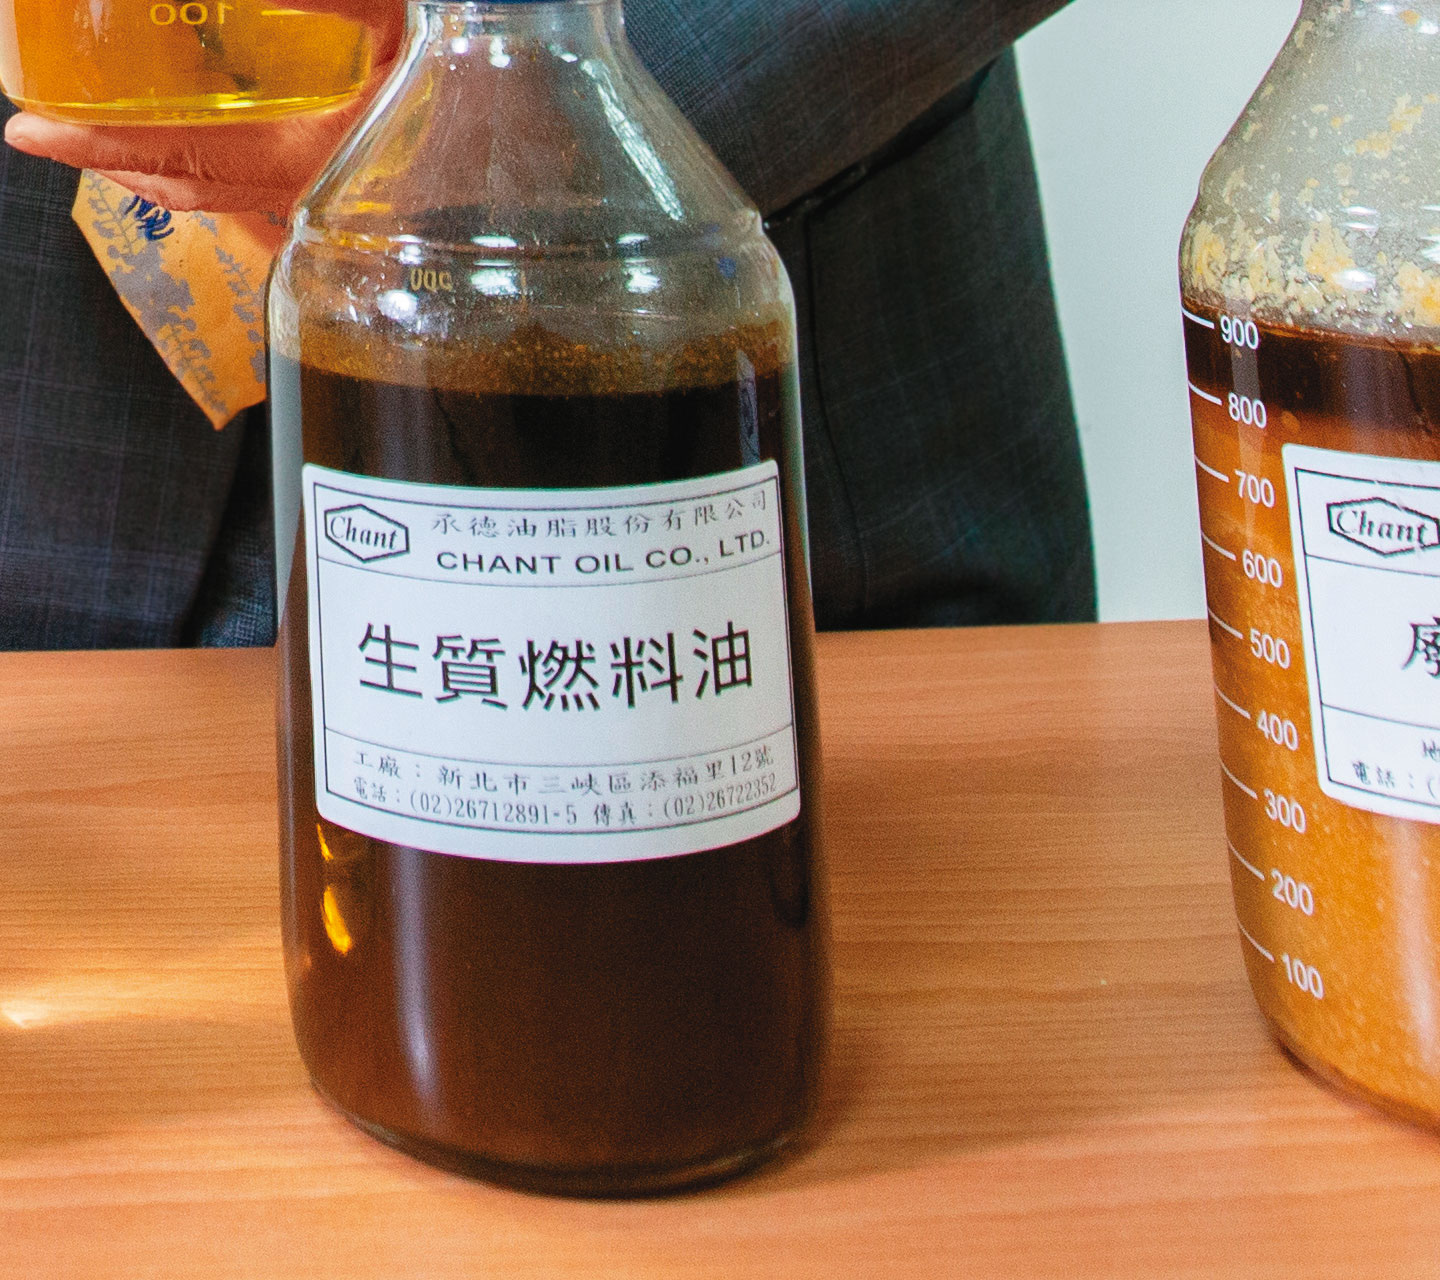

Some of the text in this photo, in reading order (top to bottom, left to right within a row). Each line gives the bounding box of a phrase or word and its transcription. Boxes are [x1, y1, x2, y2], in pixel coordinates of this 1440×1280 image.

[1220, 316, 1260, 351] 900
[1228, 393, 1268, 430] 800
[1234, 473, 1276, 510] 700
[327, 513, 399, 552] Chant
[430, 489, 768, 539] 承德油脂股份有限公司
[1334, 508, 1434, 550] Chant
[436, 528, 771, 575] CHANT OIL CO., LTD.
[1242, 551, 1283, 590] 600
[357, 620, 754, 712] 生質燃料油
[1249, 632, 1291, 671] 500
[1256, 713, 1299, 752] 400
[1264, 793, 1307, 834] 300
[1271, 873, 1315, 917] 200
[1280, 953, 1325, 1001] 100
